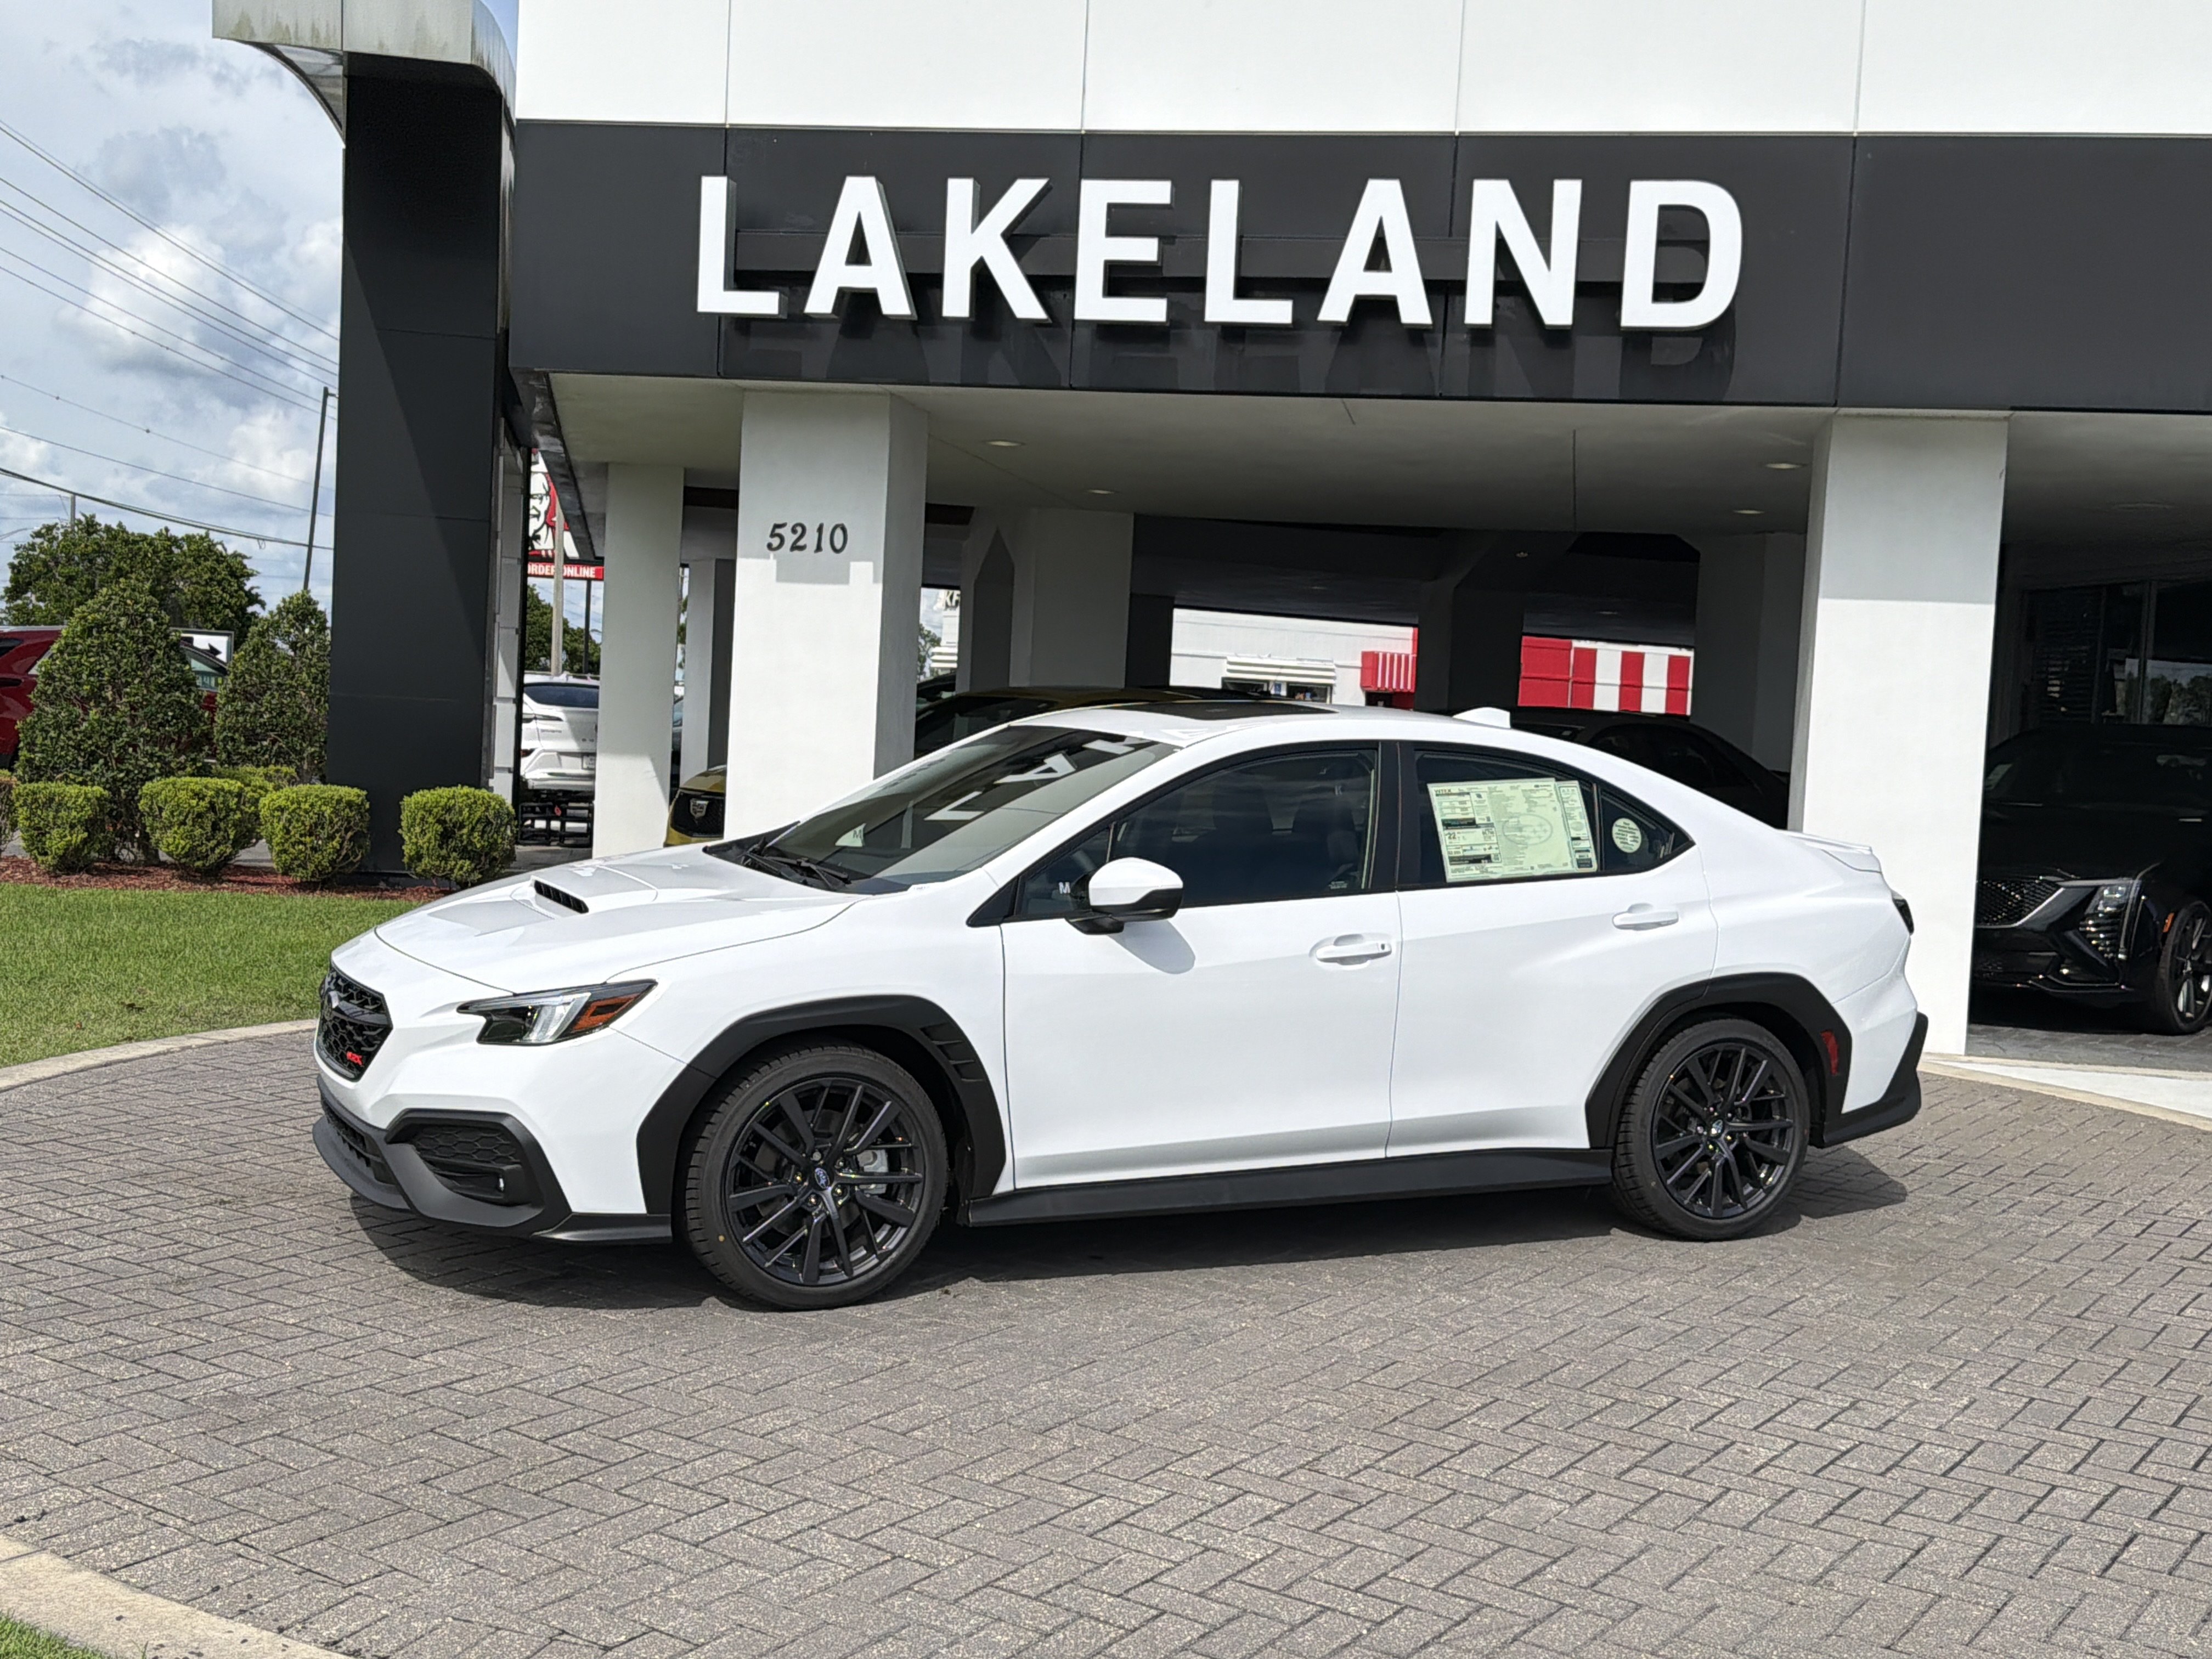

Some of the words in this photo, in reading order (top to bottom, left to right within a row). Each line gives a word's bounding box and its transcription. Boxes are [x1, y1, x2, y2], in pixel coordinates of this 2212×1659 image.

[697, 175, 1743, 329] LAKELAND
[766, 522, 848, 554] 5210
[1058, 882, 1071, 894] M
